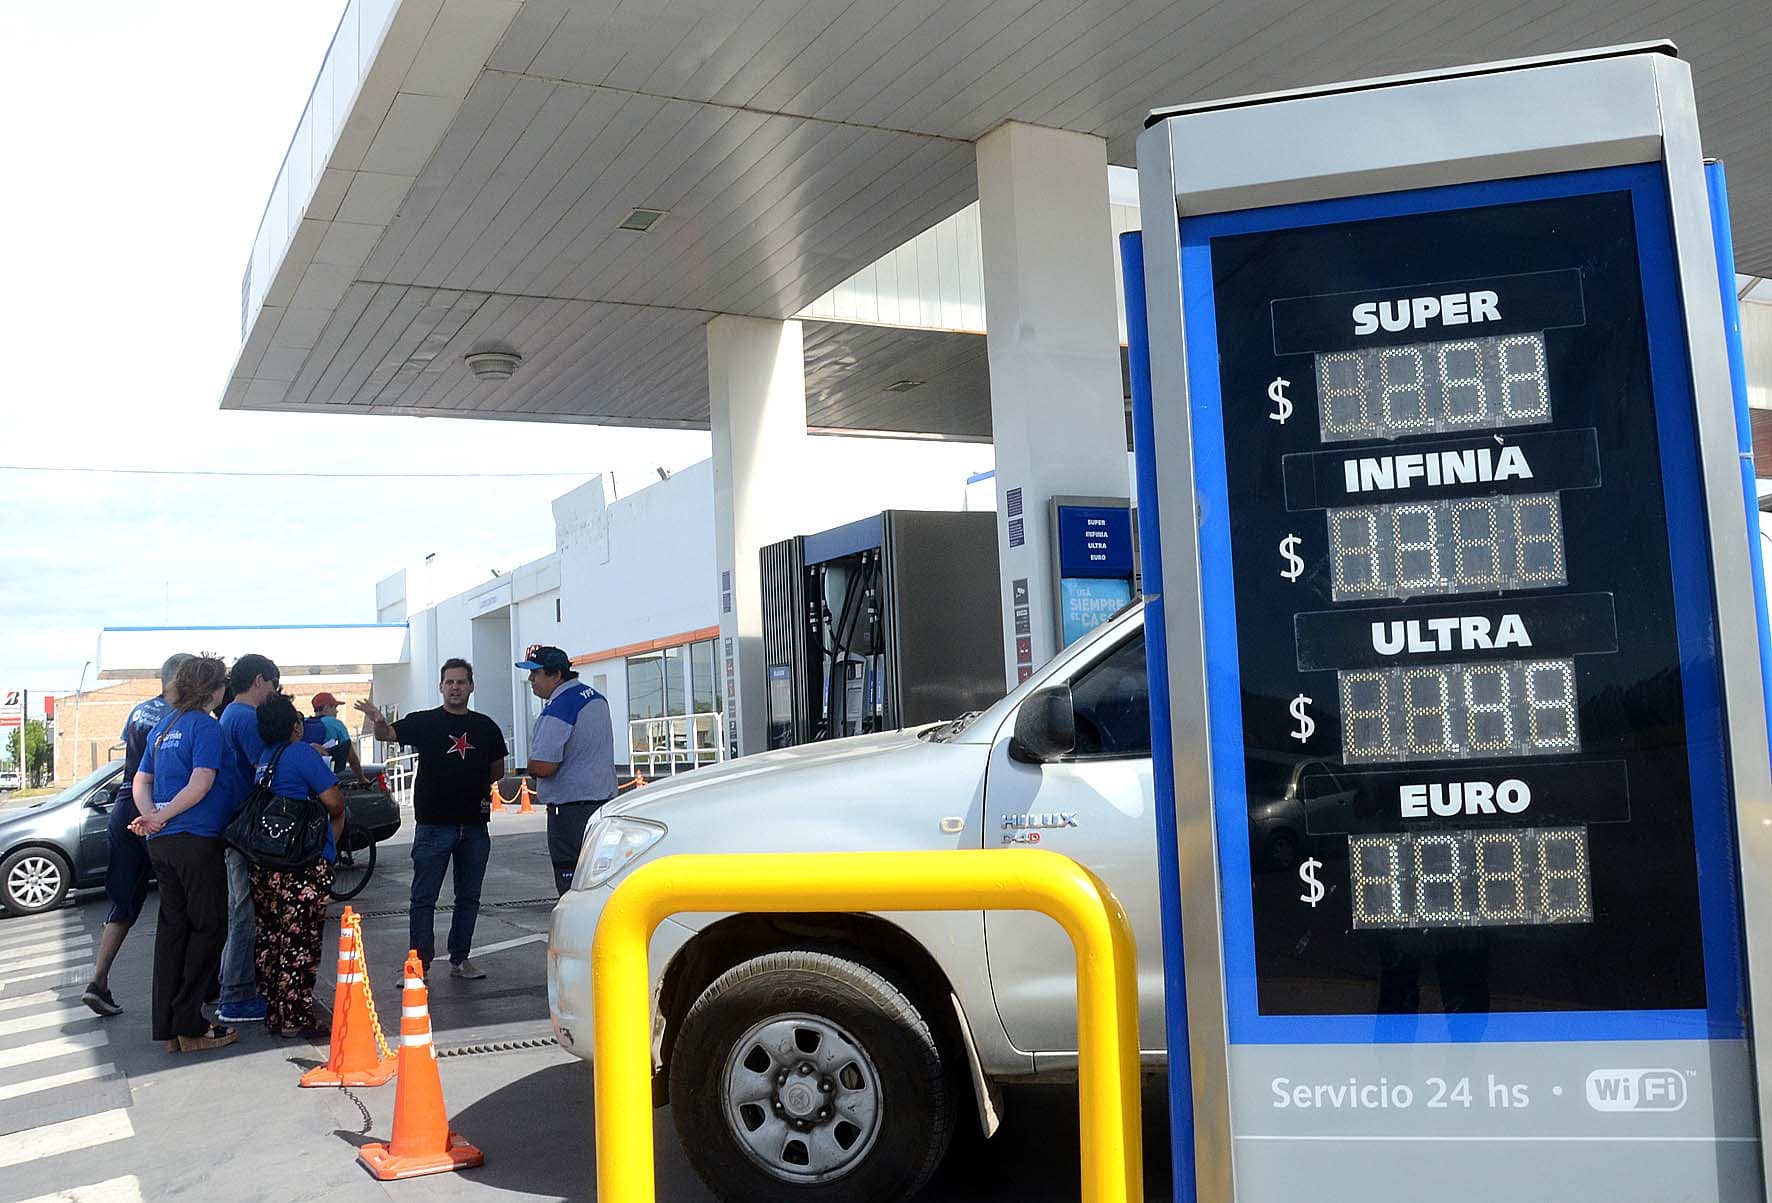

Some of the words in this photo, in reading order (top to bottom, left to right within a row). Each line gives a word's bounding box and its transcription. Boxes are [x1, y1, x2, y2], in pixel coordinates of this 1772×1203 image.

[1352, 290, 1502, 336] SUPER
[1267, 376, 1293, 425] $
[1279, 533, 1305, 583] $
[1071, 599, 1124, 612] SIEMPRE
[1371, 614, 1533, 656] ULTRA
[579, 687, 595, 700] YPF
[1289, 693, 1315, 744] $
[1399, 779, 1531, 818] EURO
[1001, 811, 1079, 830] HILUX
[1299, 856, 1325, 908] $
[1271, 1076, 1414, 1109] Servicio
[1425, 1076, 1473, 1109] 24
[1487, 1074, 1530, 1109] hs
